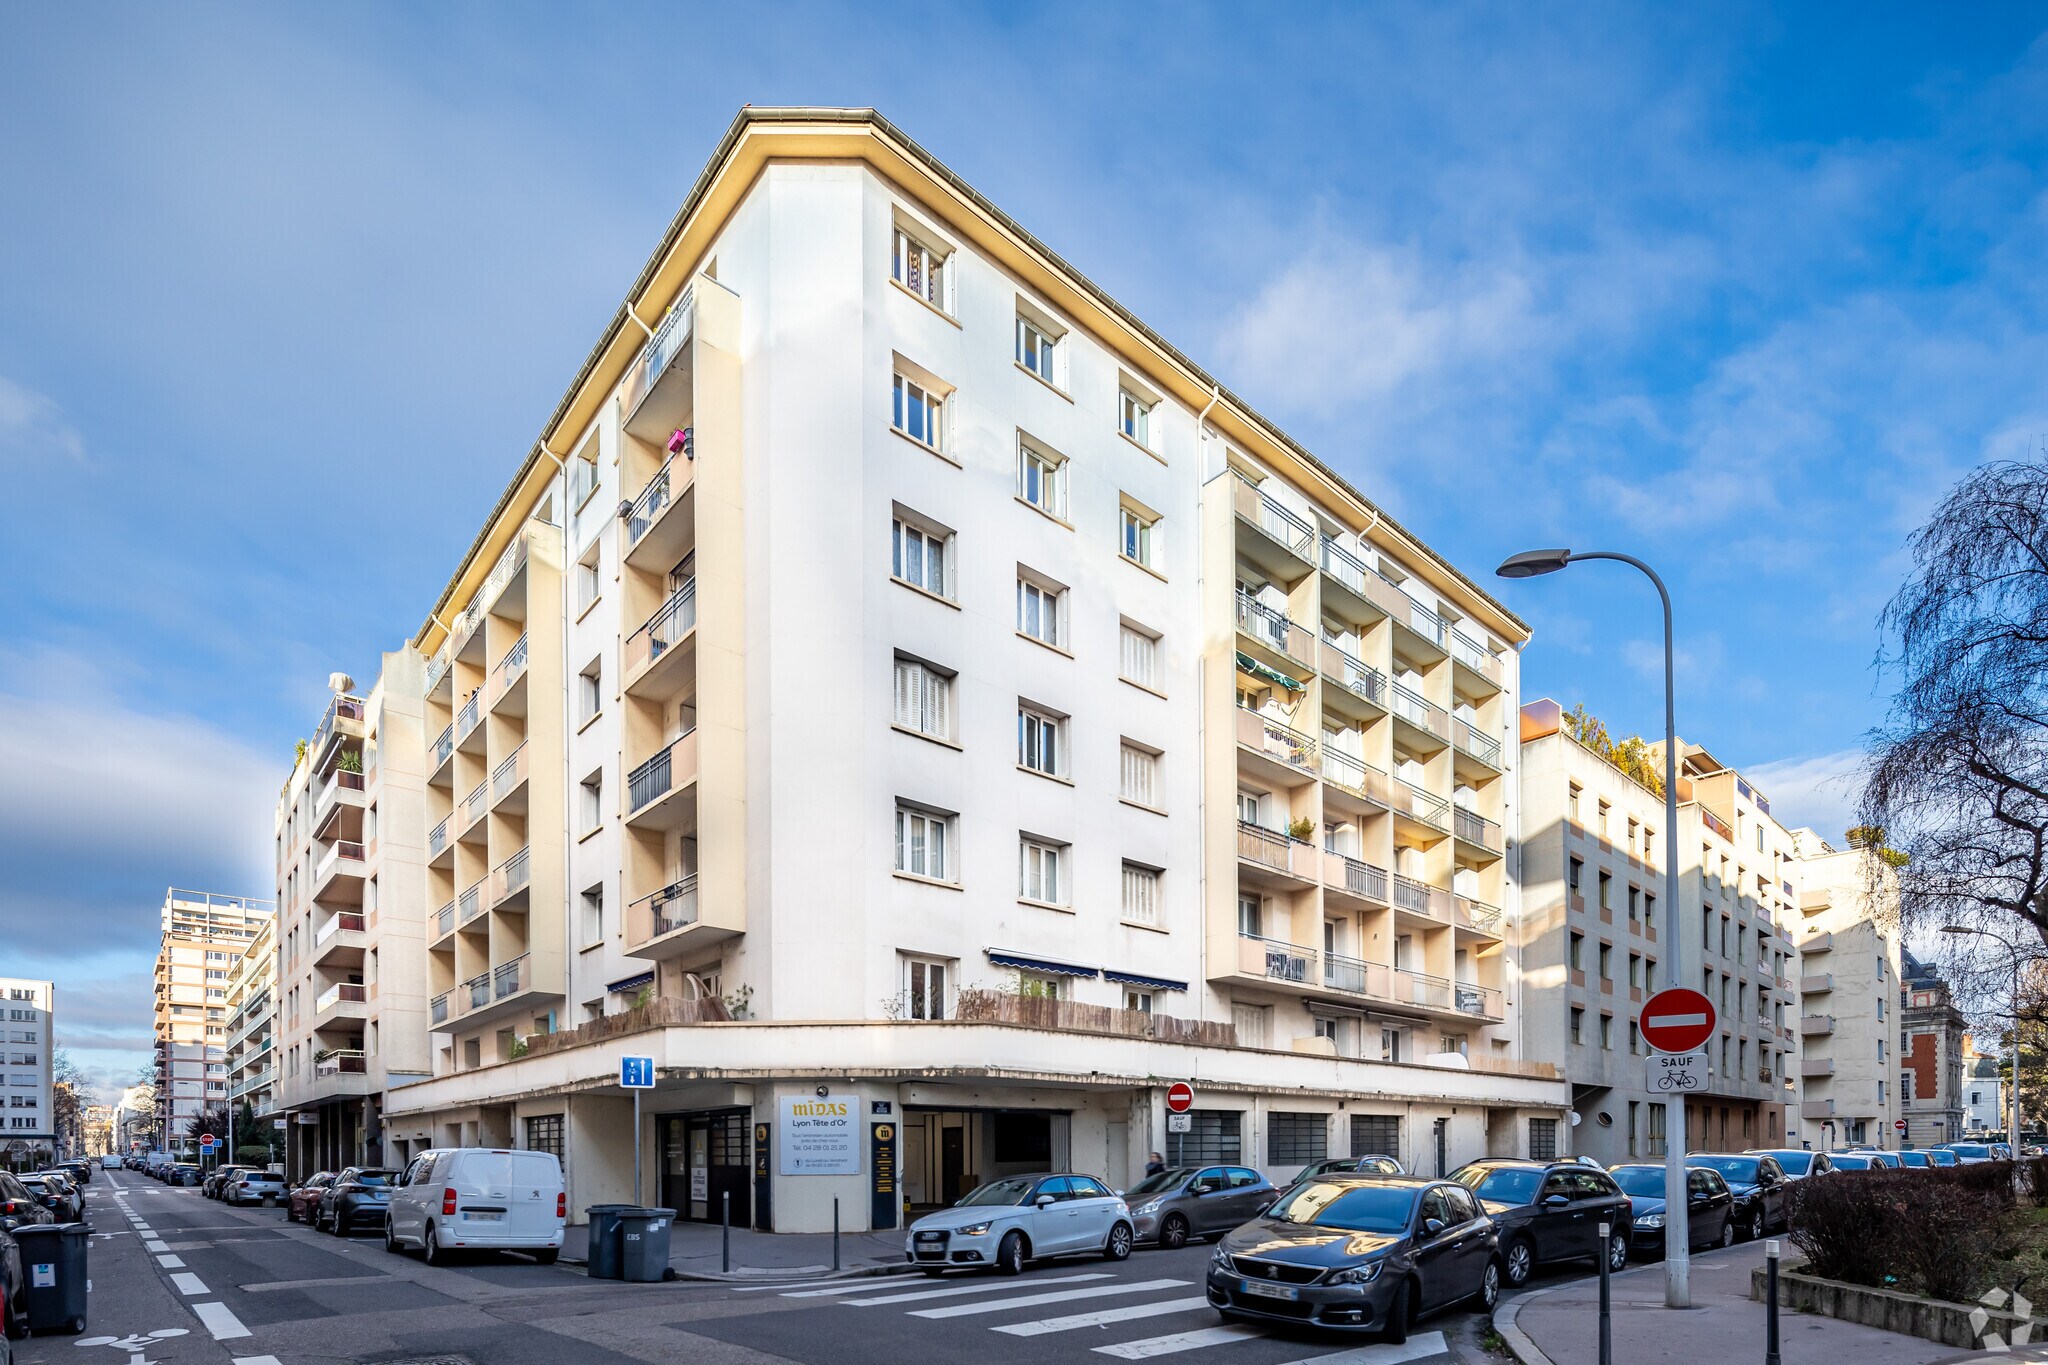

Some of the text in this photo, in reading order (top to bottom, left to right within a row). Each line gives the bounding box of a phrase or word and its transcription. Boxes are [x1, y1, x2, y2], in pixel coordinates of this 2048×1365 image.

[1661, 1057, 1693, 1067] SAUF
[792, 1119, 847, 1128] Lyon Tête d'Or
